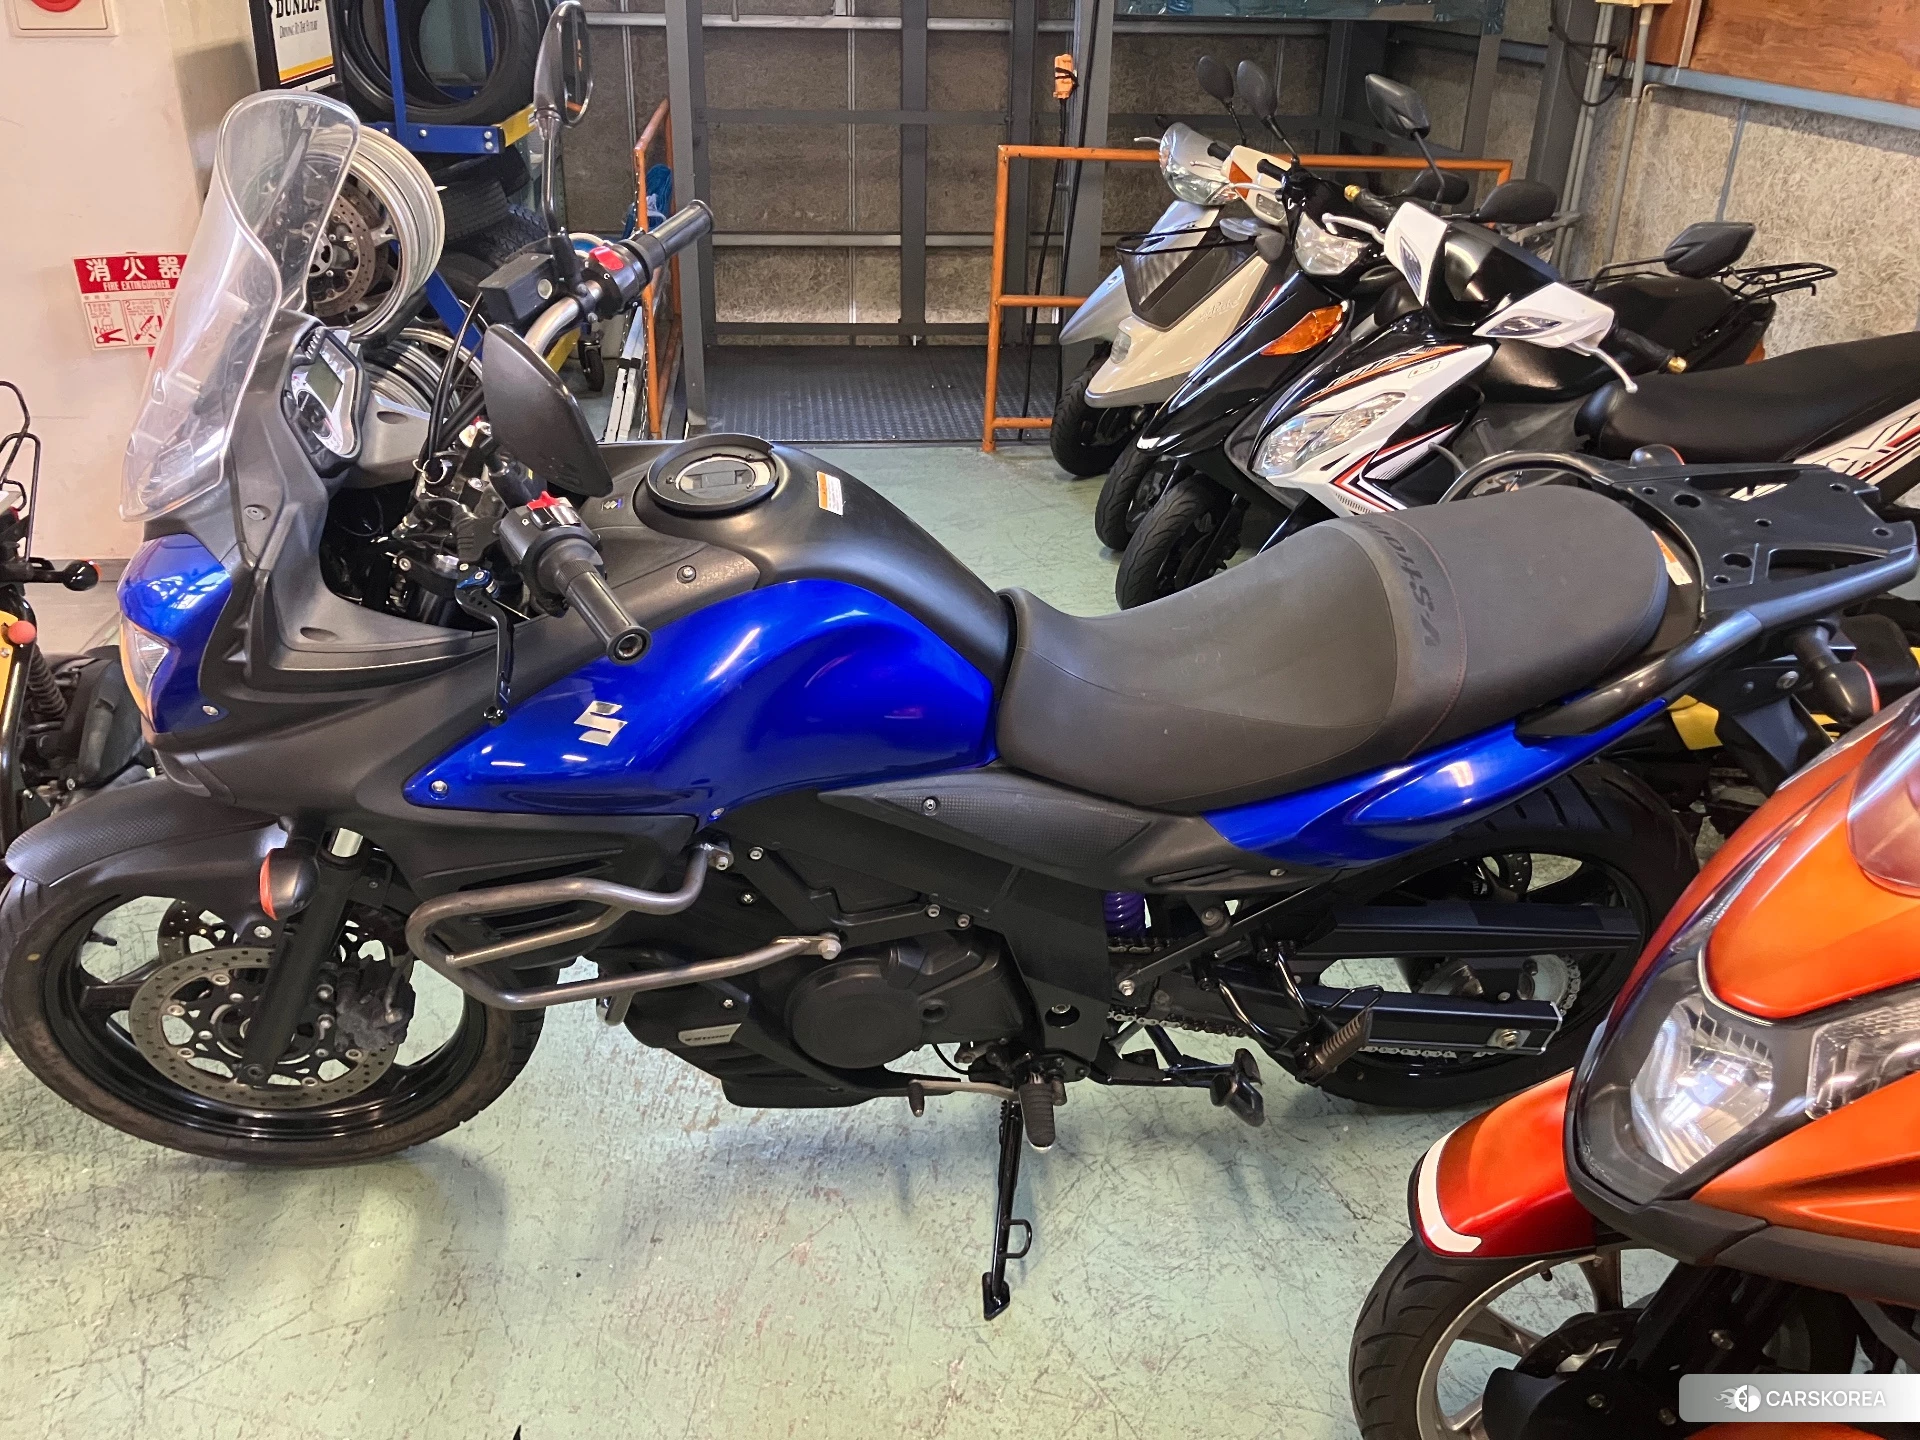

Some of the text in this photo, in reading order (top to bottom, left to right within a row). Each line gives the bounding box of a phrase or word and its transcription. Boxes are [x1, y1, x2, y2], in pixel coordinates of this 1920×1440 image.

[86, 256, 180, 282] 消火器
[103, 279, 171, 292] FIRE EXTINGUISHER
